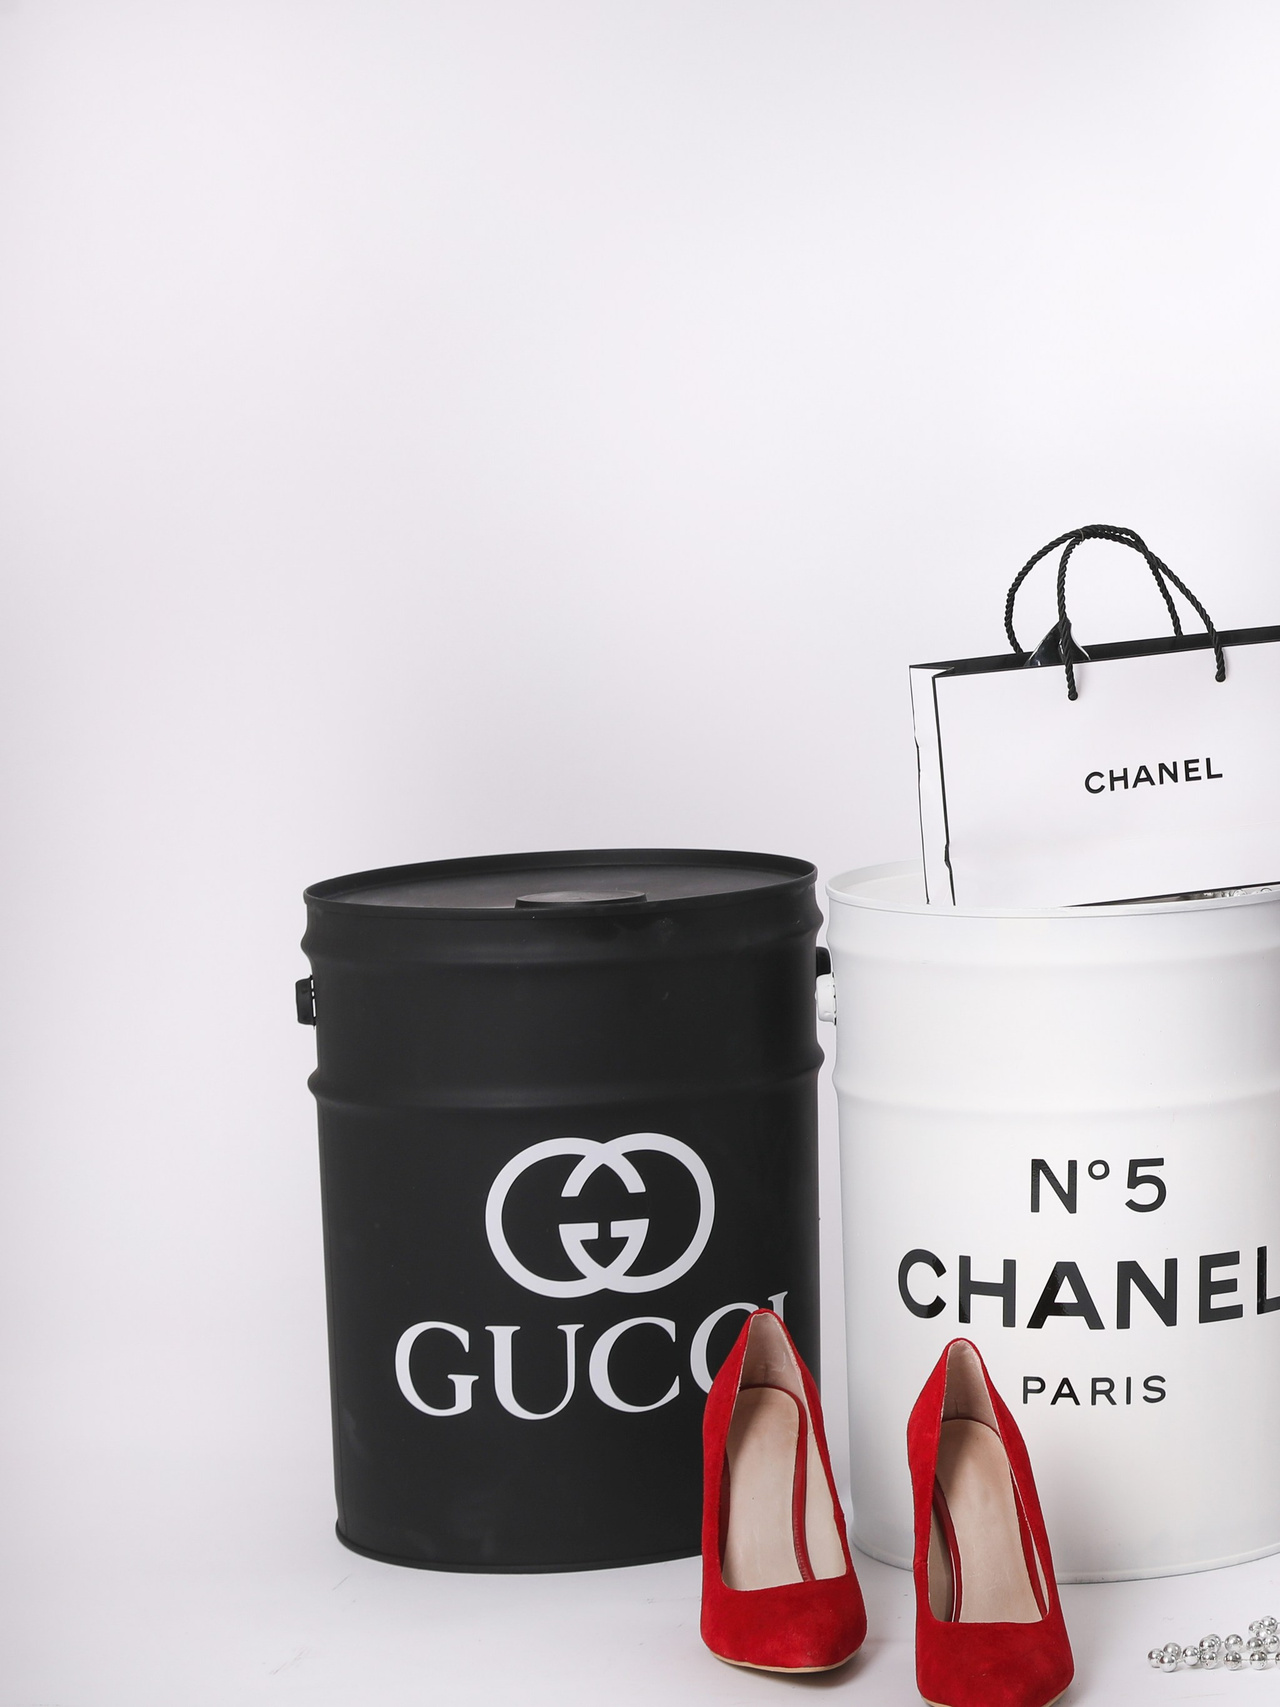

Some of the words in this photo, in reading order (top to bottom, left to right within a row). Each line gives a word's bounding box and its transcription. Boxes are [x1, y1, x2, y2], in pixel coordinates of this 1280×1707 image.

[1084, 757, 1223, 794] CHANEL
[395, 1291, 788, 1420] GUCC
[1022, 1375, 1167, 1406] PARIS
